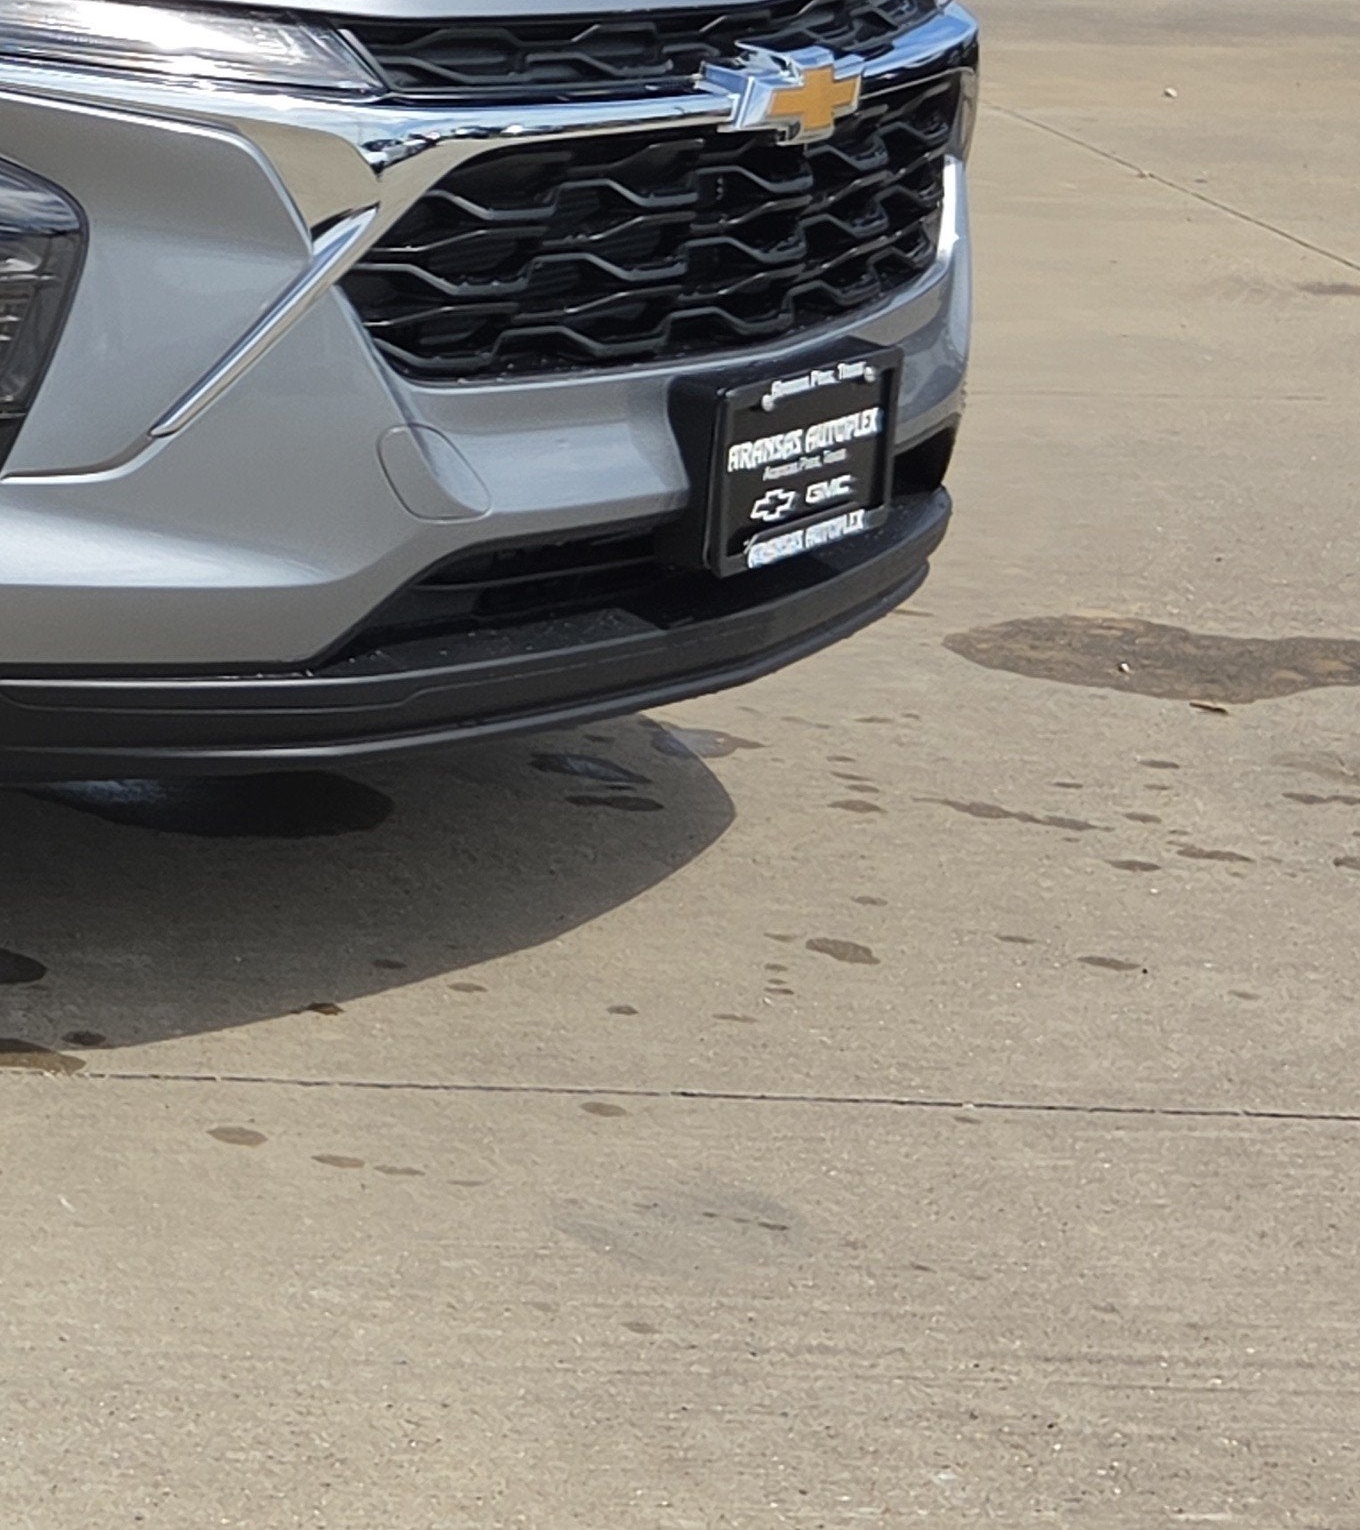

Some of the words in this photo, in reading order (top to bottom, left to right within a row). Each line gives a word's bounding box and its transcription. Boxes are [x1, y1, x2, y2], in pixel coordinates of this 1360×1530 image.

[727, 429, 804, 472] ARANSAS
[805, 407, 880, 452] AUTOPLEX
[805, 475, 852, 503] GMC
